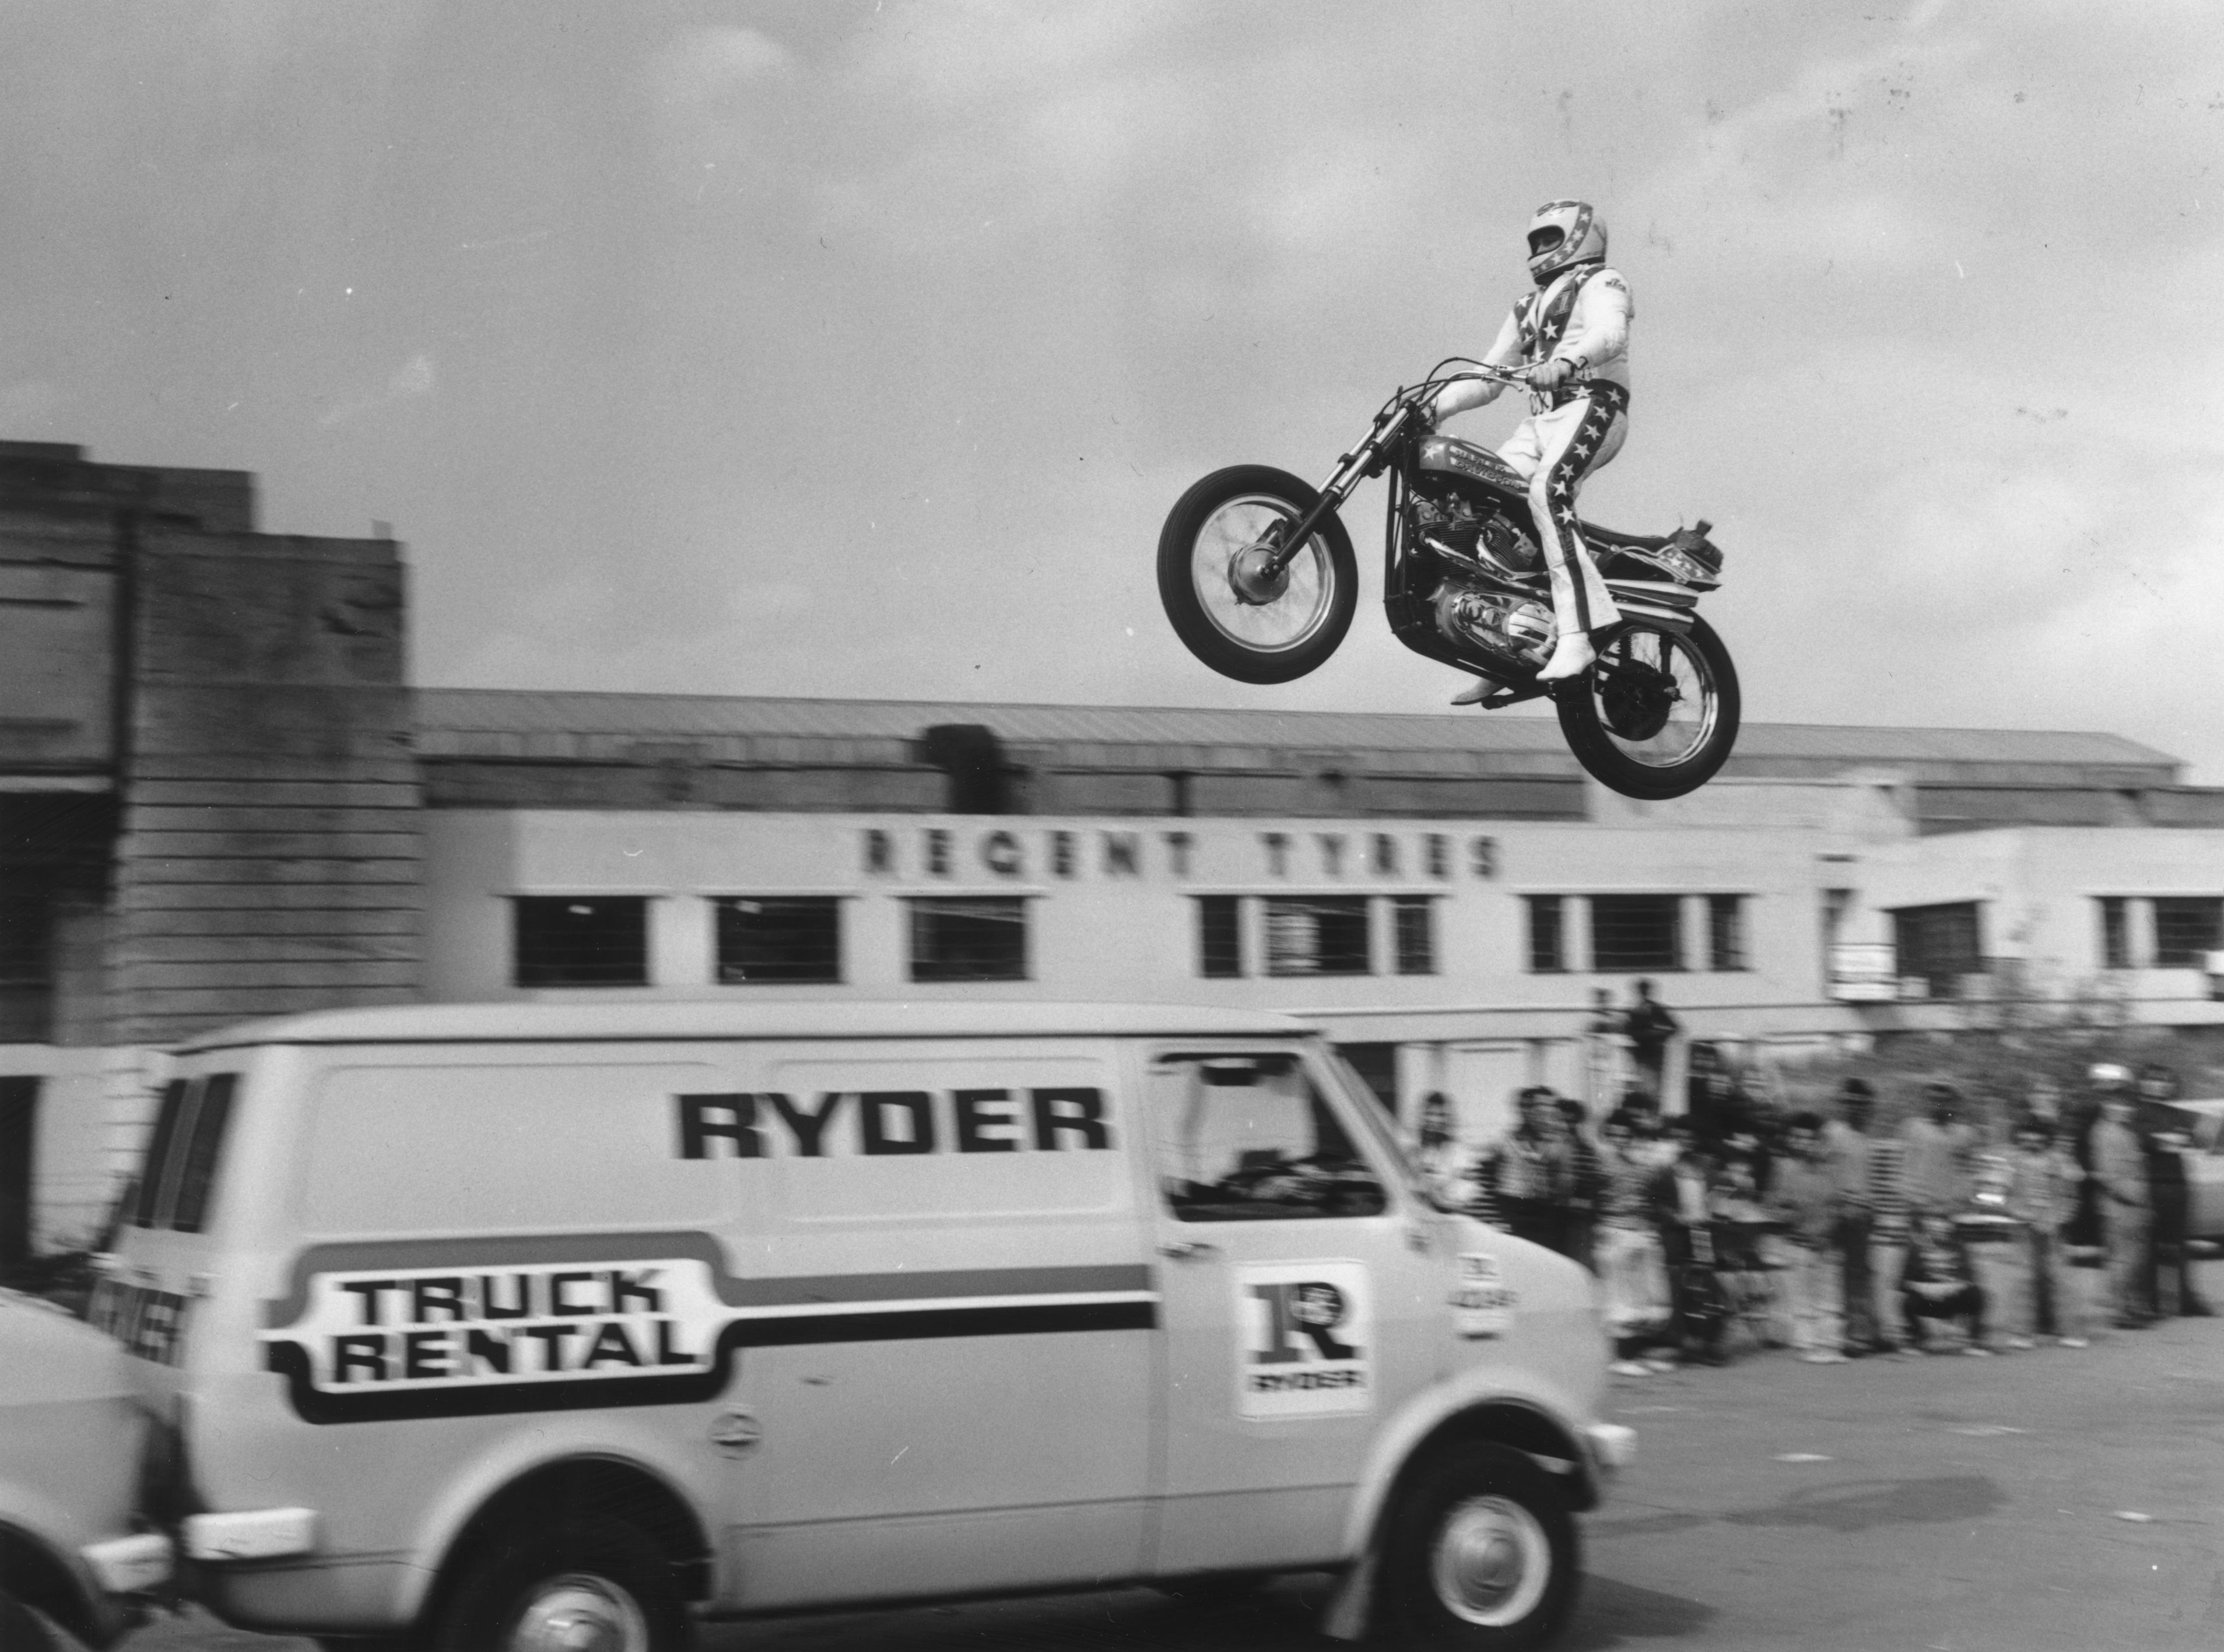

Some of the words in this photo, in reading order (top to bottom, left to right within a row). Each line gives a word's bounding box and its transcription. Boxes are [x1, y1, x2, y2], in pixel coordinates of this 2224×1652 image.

[1257, 832, 1500, 882] TYRES
[673, 1087, 1114, 1159] RYDER
[337, 1268, 672, 1326] TRUCK
[329, 1320, 708, 1384] RENTAL
